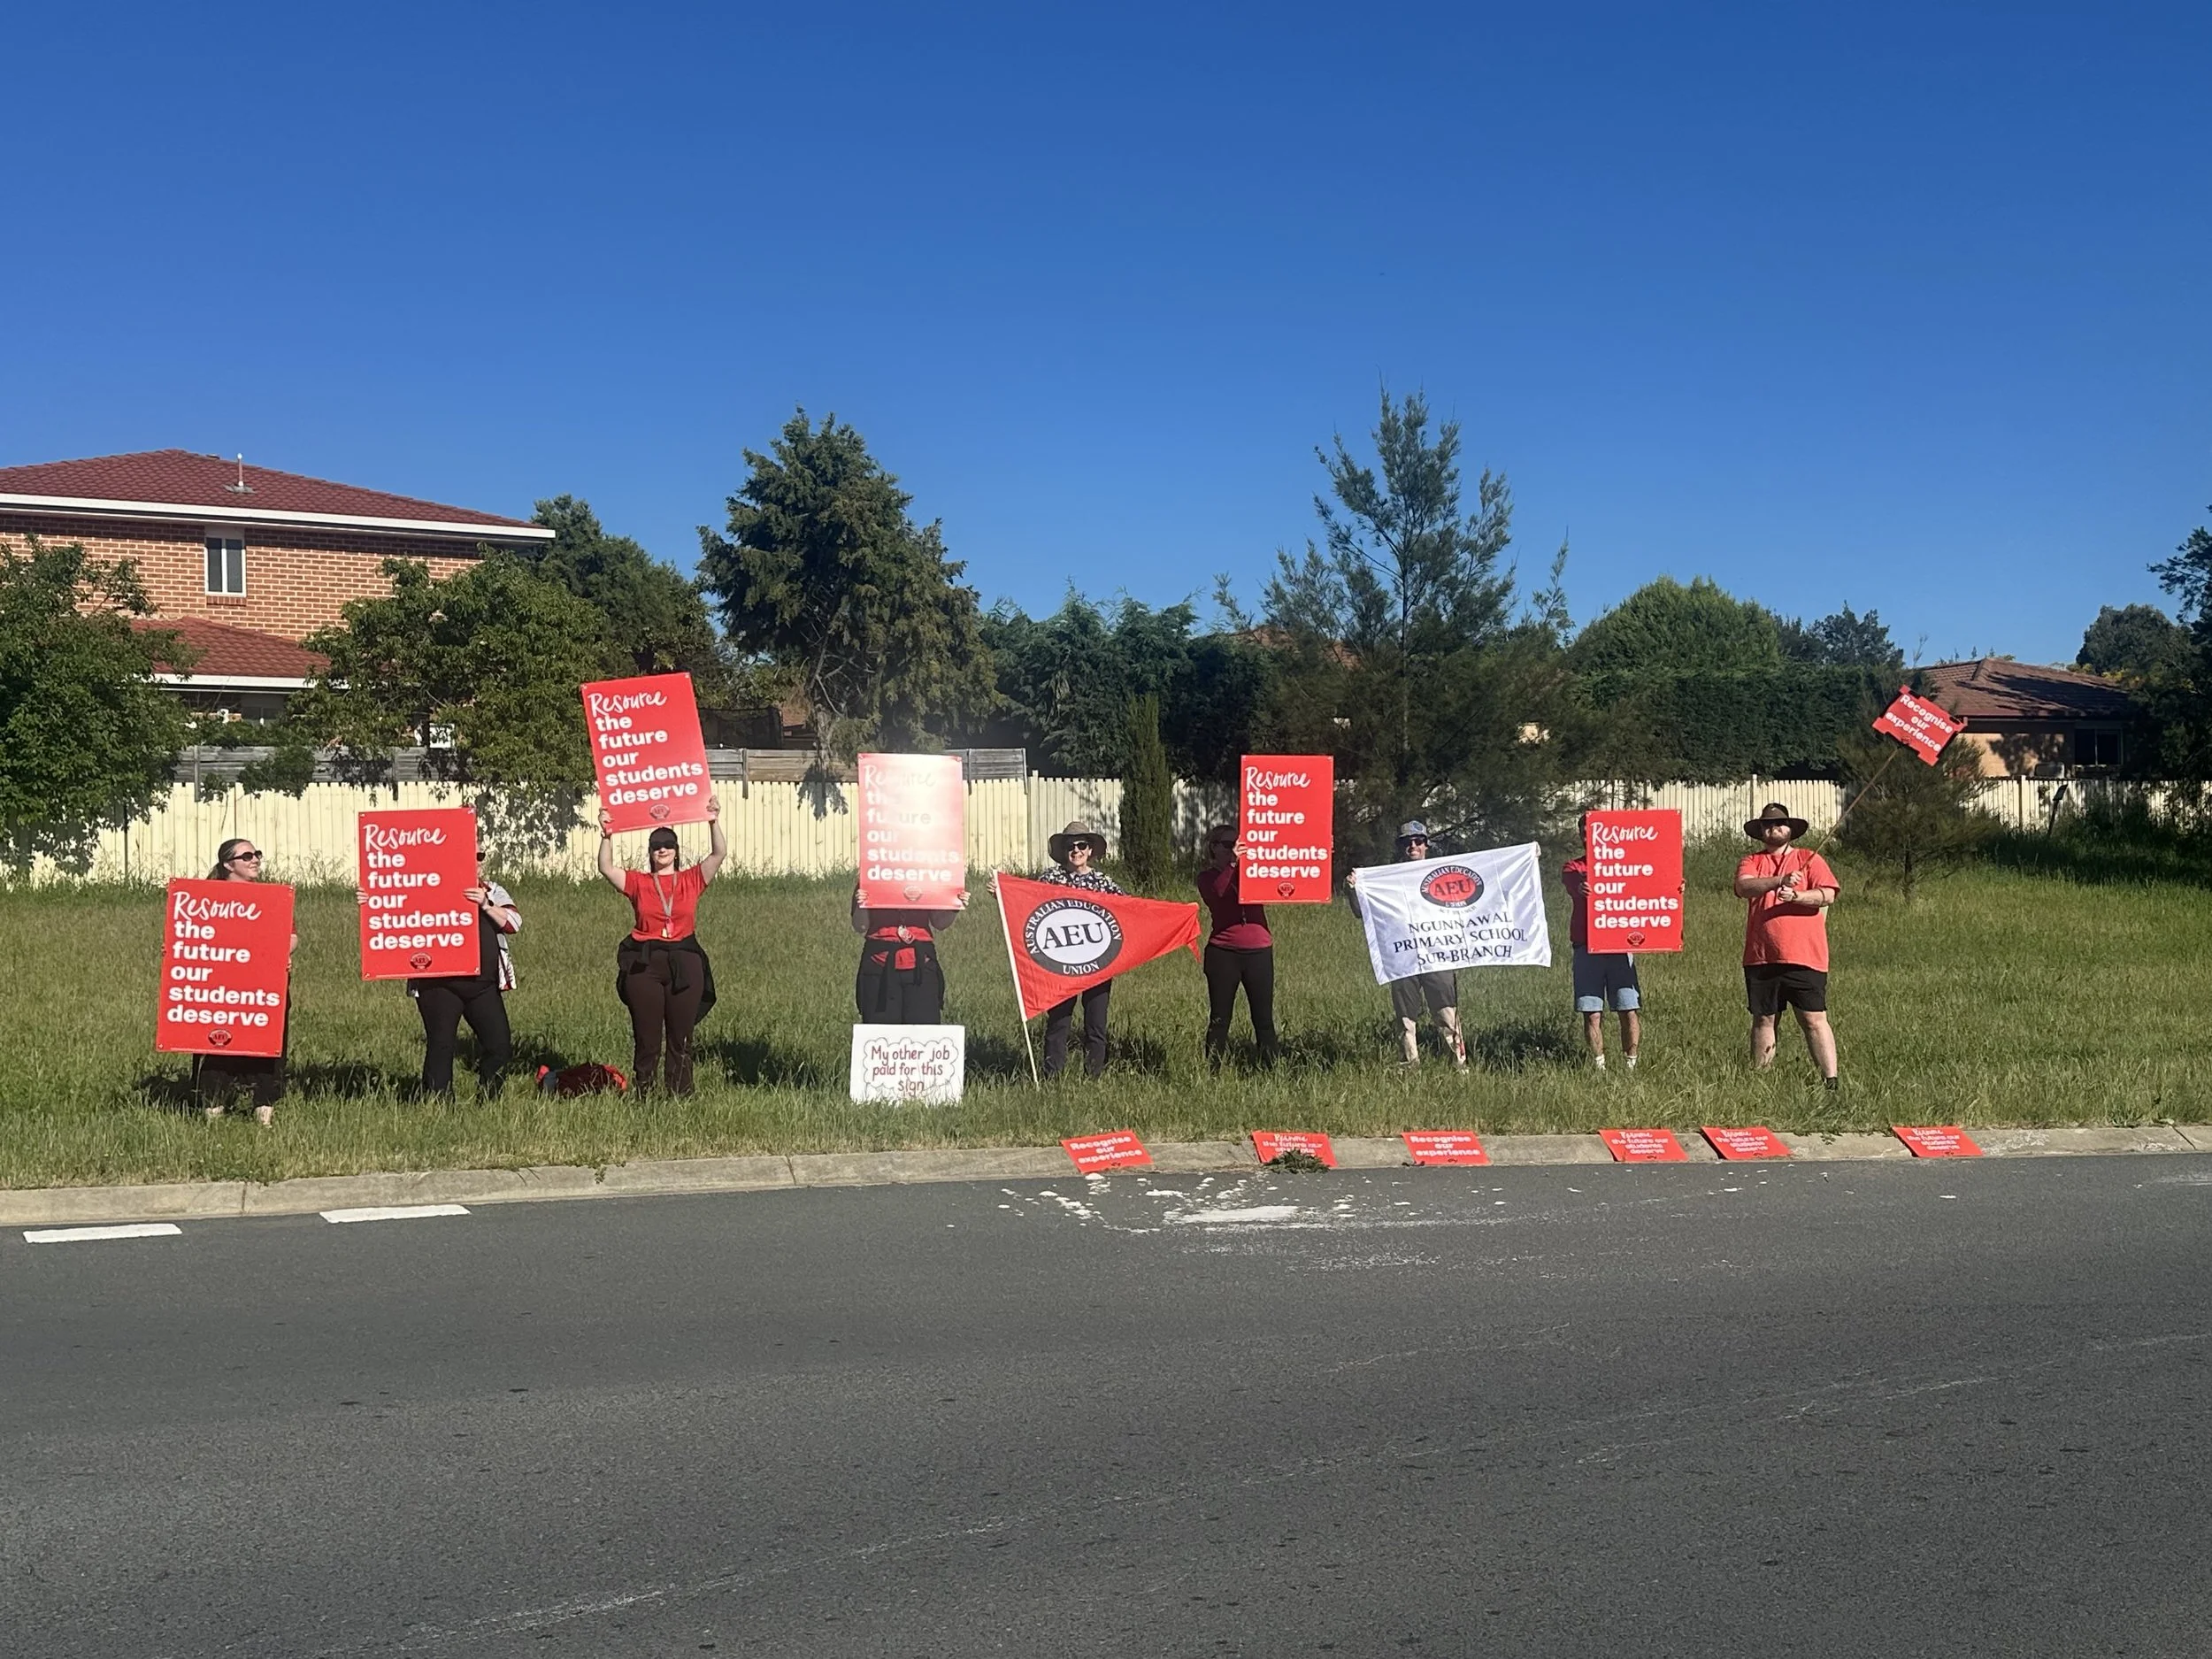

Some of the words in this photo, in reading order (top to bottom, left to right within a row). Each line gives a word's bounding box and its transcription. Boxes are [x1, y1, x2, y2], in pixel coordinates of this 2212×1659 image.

[588, 691, 667, 718] Resource
[1900, 695, 1953, 733] Recognise
[595, 715, 633, 732] the
[1886, 712, 1941, 751] experience
[1911, 717, 1931, 730] our
[598, 729, 668, 749] future
[602, 752, 639, 768] our
[605, 762, 703, 787] students
[864, 764, 936, 791] Reurce
[1245, 765, 1311, 792] Resource
[609, 782, 698, 806] deserve
[866, 790, 900, 805] th
[1247, 791, 1278, 807] the
[866, 807, 932, 825] fuure
[1247, 808, 1305, 825] future
[363, 824, 447, 852] Resource
[1246, 829, 1279, 842] our
[1590, 821, 1658, 846] Resource
[367, 851, 406, 868] the
[867, 847, 960, 864] studts
[1246, 844, 1328, 860] students
[1593, 845, 1625, 860] the
[867, 864, 952, 882] deserve
[1246, 863, 1321, 879] deserve
[1593, 862, 1654, 877] future
[368, 871, 442, 889] future
[1434, 879, 1471, 895] AEU
[1594, 881, 1626, 895] our
[173, 891, 262, 921] Resource
[368, 894, 408, 909] our
[1594, 895, 1678, 911] students
[368, 910, 473, 929] students
[1025, 900, 1066, 954] AUSTRALIAN
[1066, 900, 1122, 941] EDUCATION
[1409, 911, 1512, 933] NGUNNAWAL
[1594, 914, 1671, 929] deserve
[174, 920, 215, 940] the
[1042, 922, 1102, 949] AEU
[369, 932, 465, 950] deserve
[1394, 933, 1464, 953] PRIMARY
[1470, 928, 1527, 941] SCHOOL
[173, 941, 250, 963] future
[1417, 945, 1512, 965] SUB-BRANCH
[170, 965, 212, 981] our
[1063, 961, 1100, 974] UNION
[168, 985, 280, 1007] students
[166, 1004, 269, 1027] deserve
[871, 1045, 889, 1066] My
[892, 1044, 925, 1060] other
[929, 1045, 950, 1063] job
[872, 1062, 896, 1081] paid
[899, 1062, 917, 1076] for
[922, 1062, 943, 1076] this
[897, 1080, 925, 1097] sign
